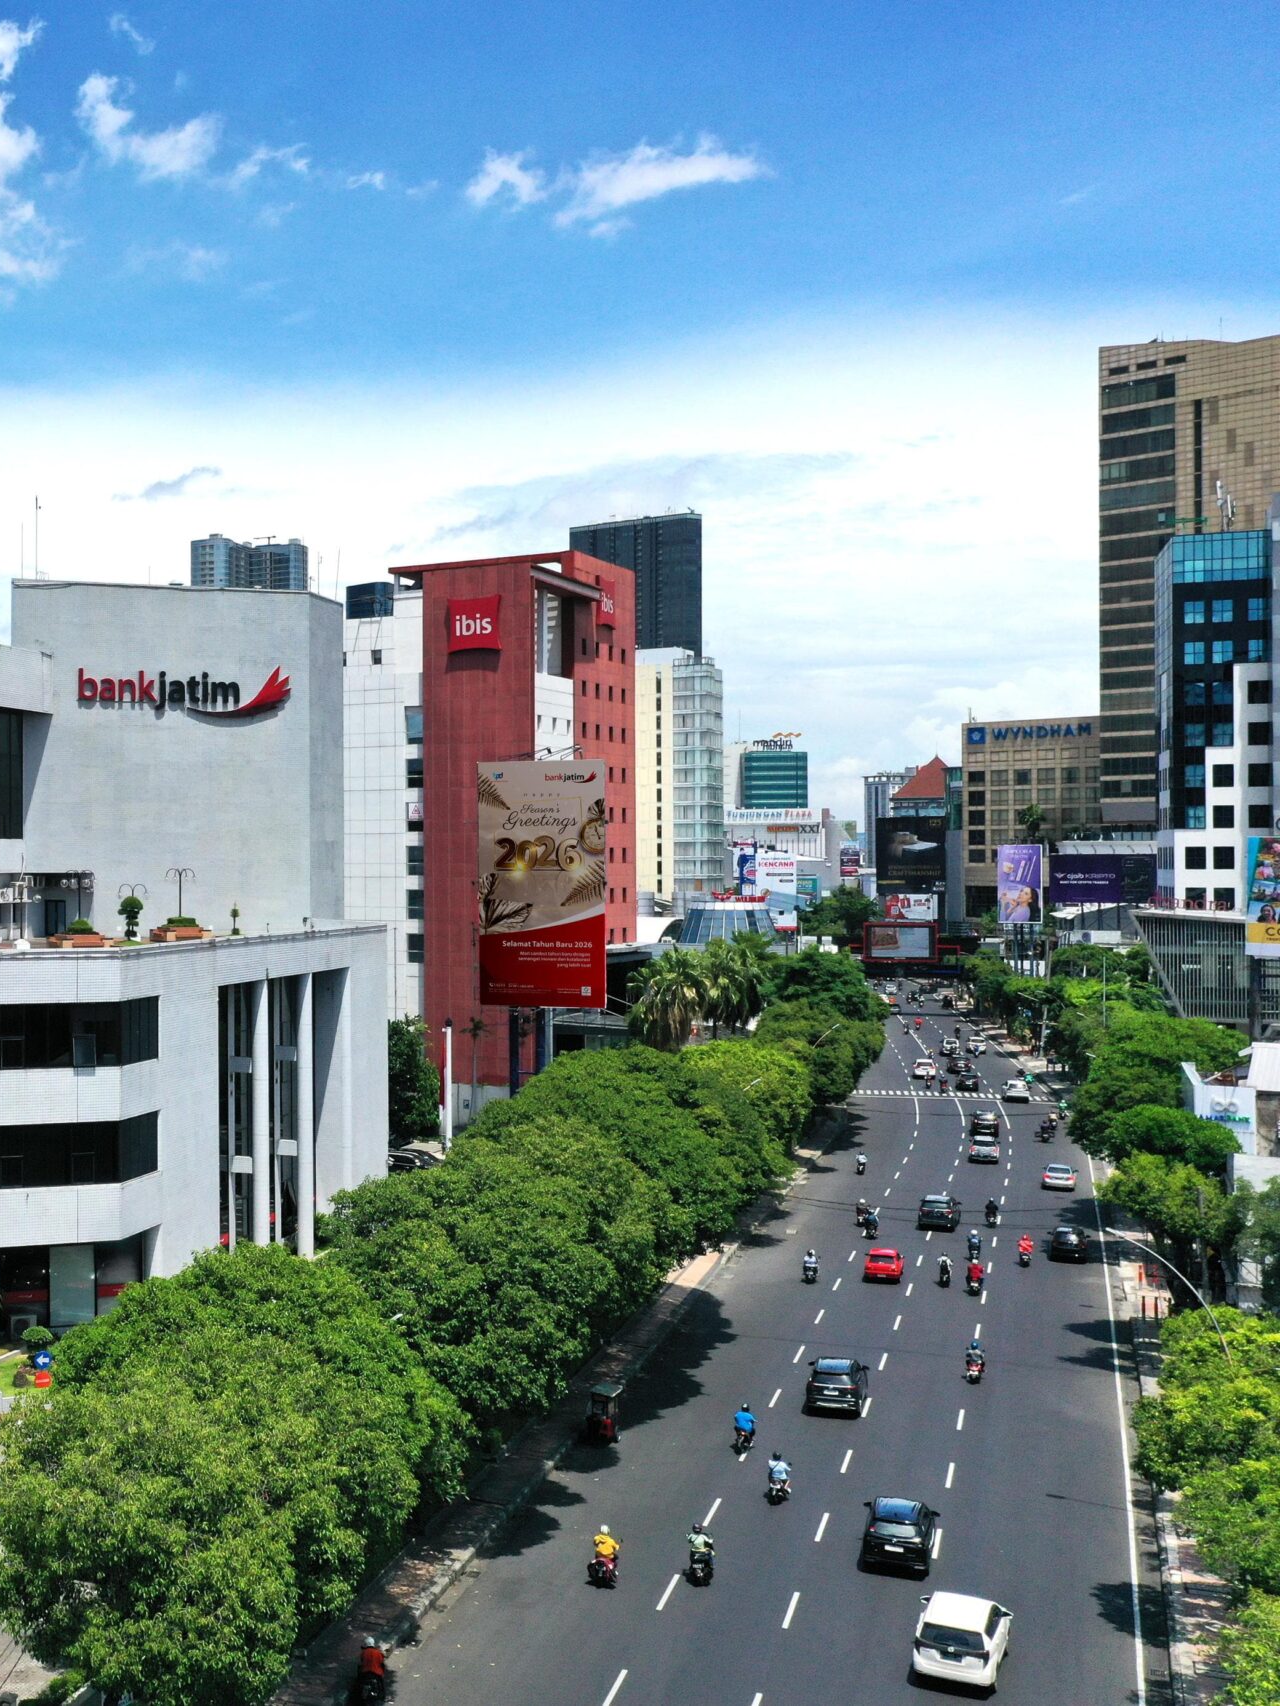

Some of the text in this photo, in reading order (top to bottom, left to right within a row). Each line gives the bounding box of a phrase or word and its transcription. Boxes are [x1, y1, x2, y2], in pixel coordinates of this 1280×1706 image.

[601, 592, 614, 614] ibis
[455, 613, 492, 636] ibis
[78, 667, 240, 710] bankjatim
[992, 723, 1091, 740] WYNDHAM
[544, 773, 585, 782] bankjatim
[520, 803, 560, 814] Season's
[727, 809, 812, 819] TUNJUNGAN PLAZA
[502, 810, 577, 834] Greetings
[800, 824, 820, 834] XXI
[495, 835, 582, 871] 2026
[532, 940, 554, 948] Tahun
